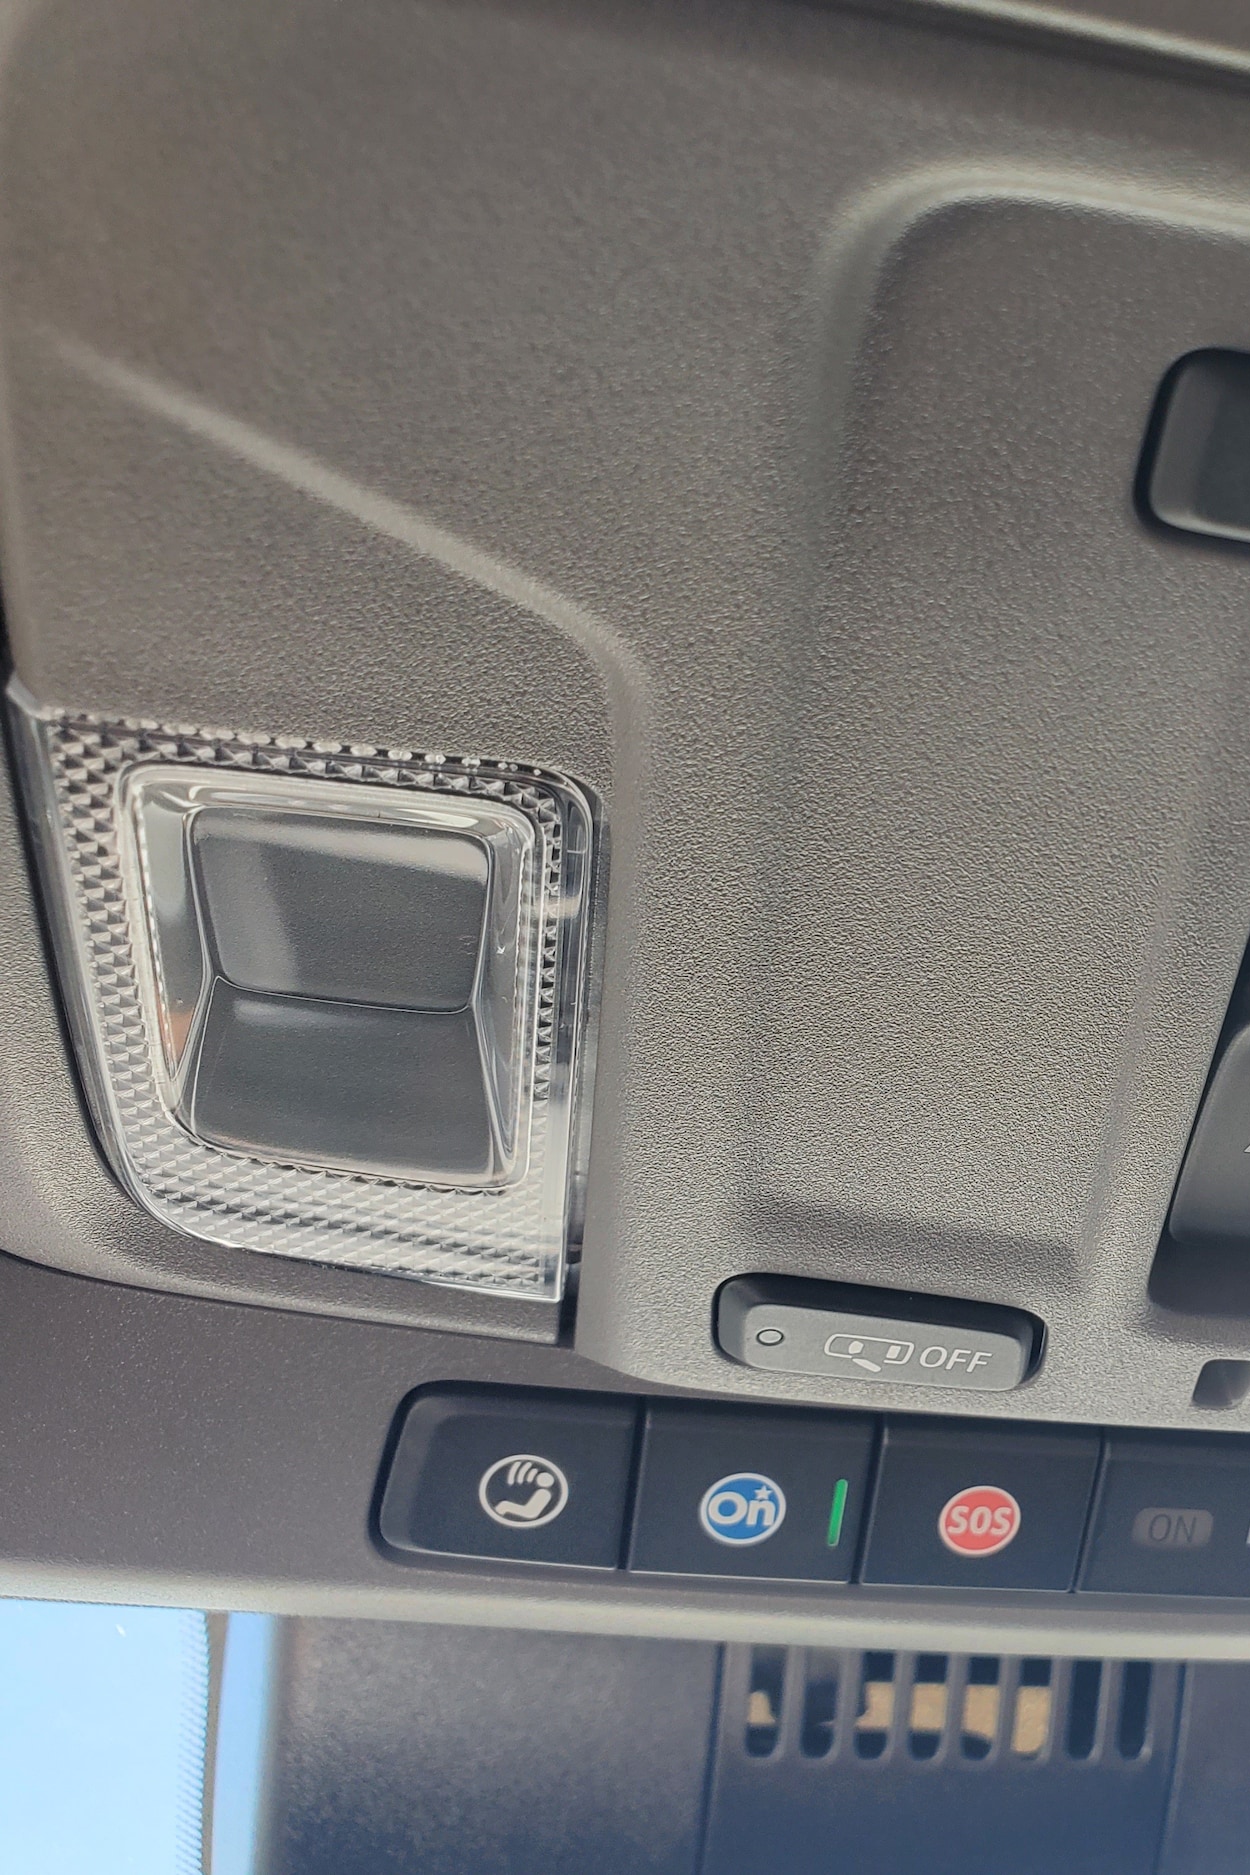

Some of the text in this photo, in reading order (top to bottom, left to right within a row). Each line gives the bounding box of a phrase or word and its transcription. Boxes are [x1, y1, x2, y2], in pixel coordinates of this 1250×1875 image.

[918, 1345, 992, 1374] OFF
[707, 1491, 777, 1528] On
[948, 1505, 1012, 1537] SOS
[1147, 1514, 1198, 1543] ON
